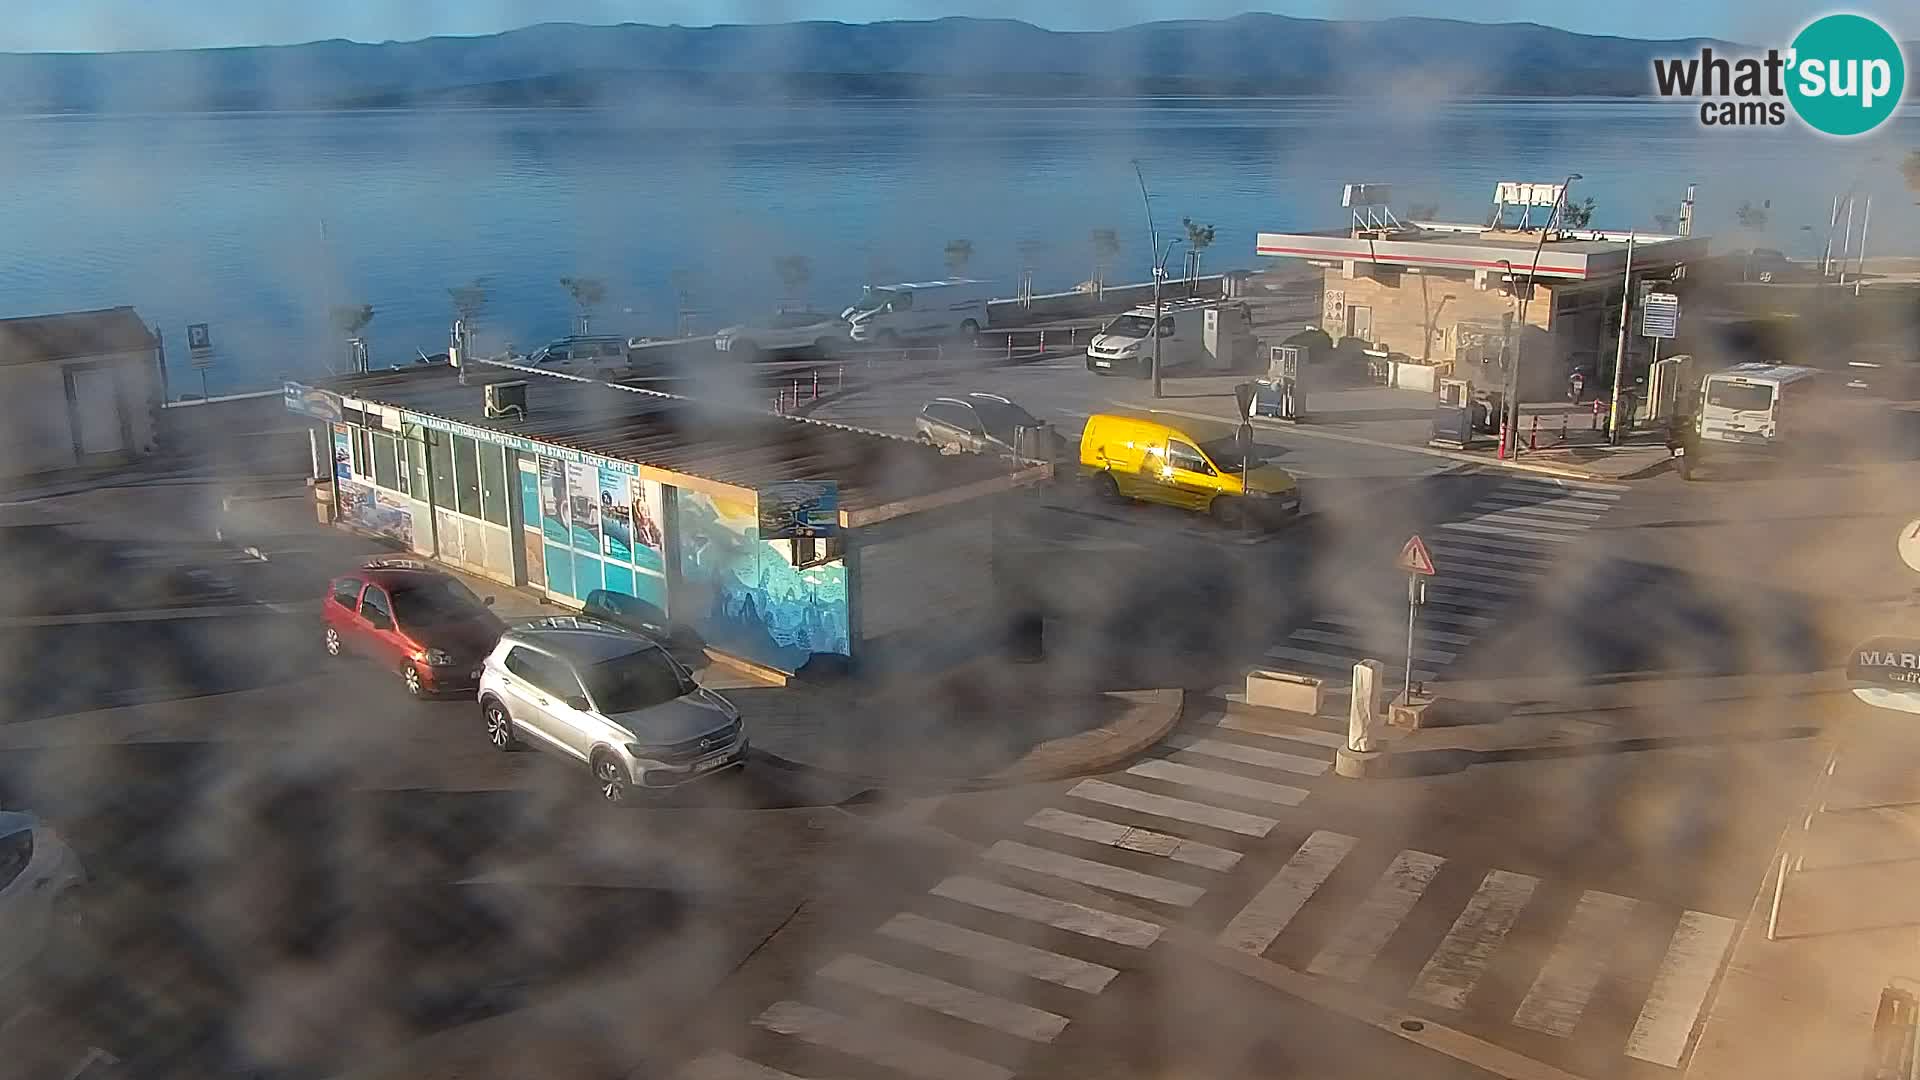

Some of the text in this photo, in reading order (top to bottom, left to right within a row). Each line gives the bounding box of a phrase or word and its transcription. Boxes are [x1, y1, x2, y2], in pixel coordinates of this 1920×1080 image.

[451, 423, 491, 441] AUTOBUSNA
[491, 432, 522, 448] POSTAJA
[532, 442, 546, 454] BUS
[547, 444, 580, 462] STATION
[582, 453, 607, 468] TICKET
[607, 459, 635, 475] OFFICE
[1859, 651, 1920, 669] MAR
[1888, 672, 1920, 684] caff
